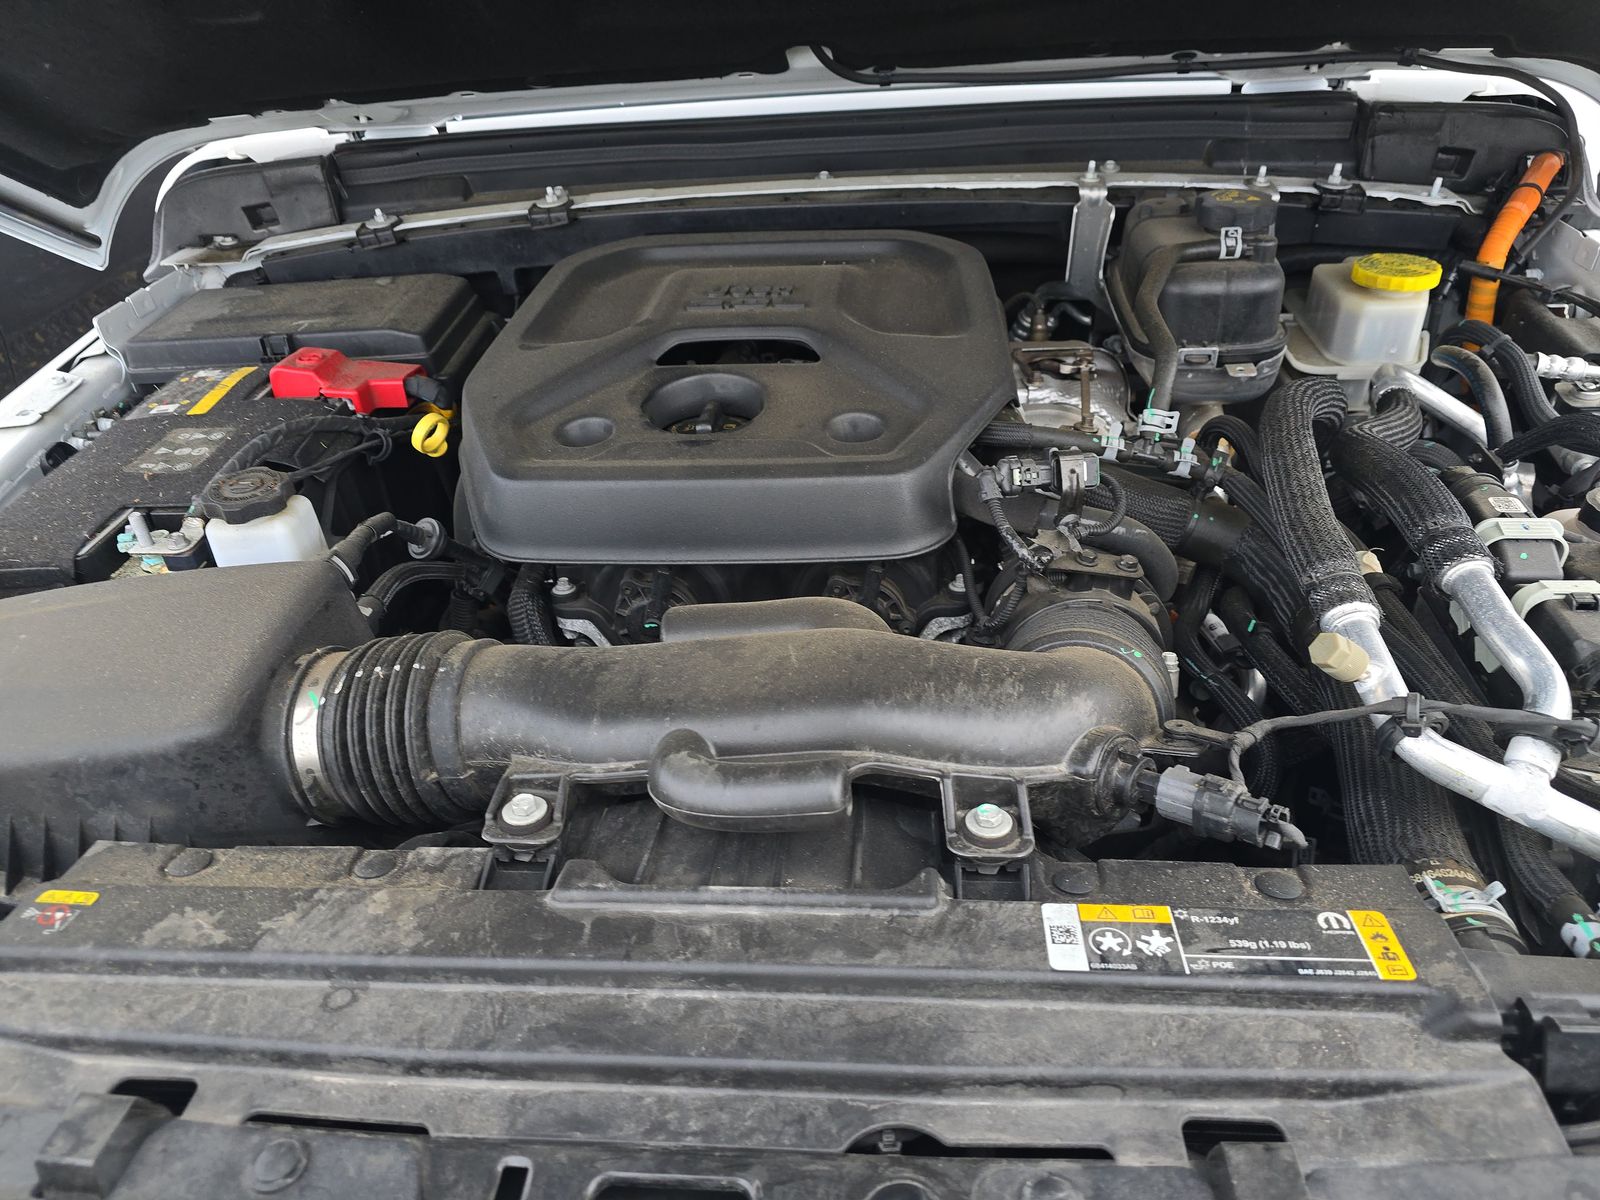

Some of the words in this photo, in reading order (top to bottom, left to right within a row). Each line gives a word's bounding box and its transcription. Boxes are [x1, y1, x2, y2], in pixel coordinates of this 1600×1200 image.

[1190, 915, 1239, 926] R-1234yf
[1228, 939, 1257, 949] 539g
[1259, 940, 1286, 950] (1.19
[1289, 941, 1312, 951] lbs)
[1211, 961, 1236, 969] POE
